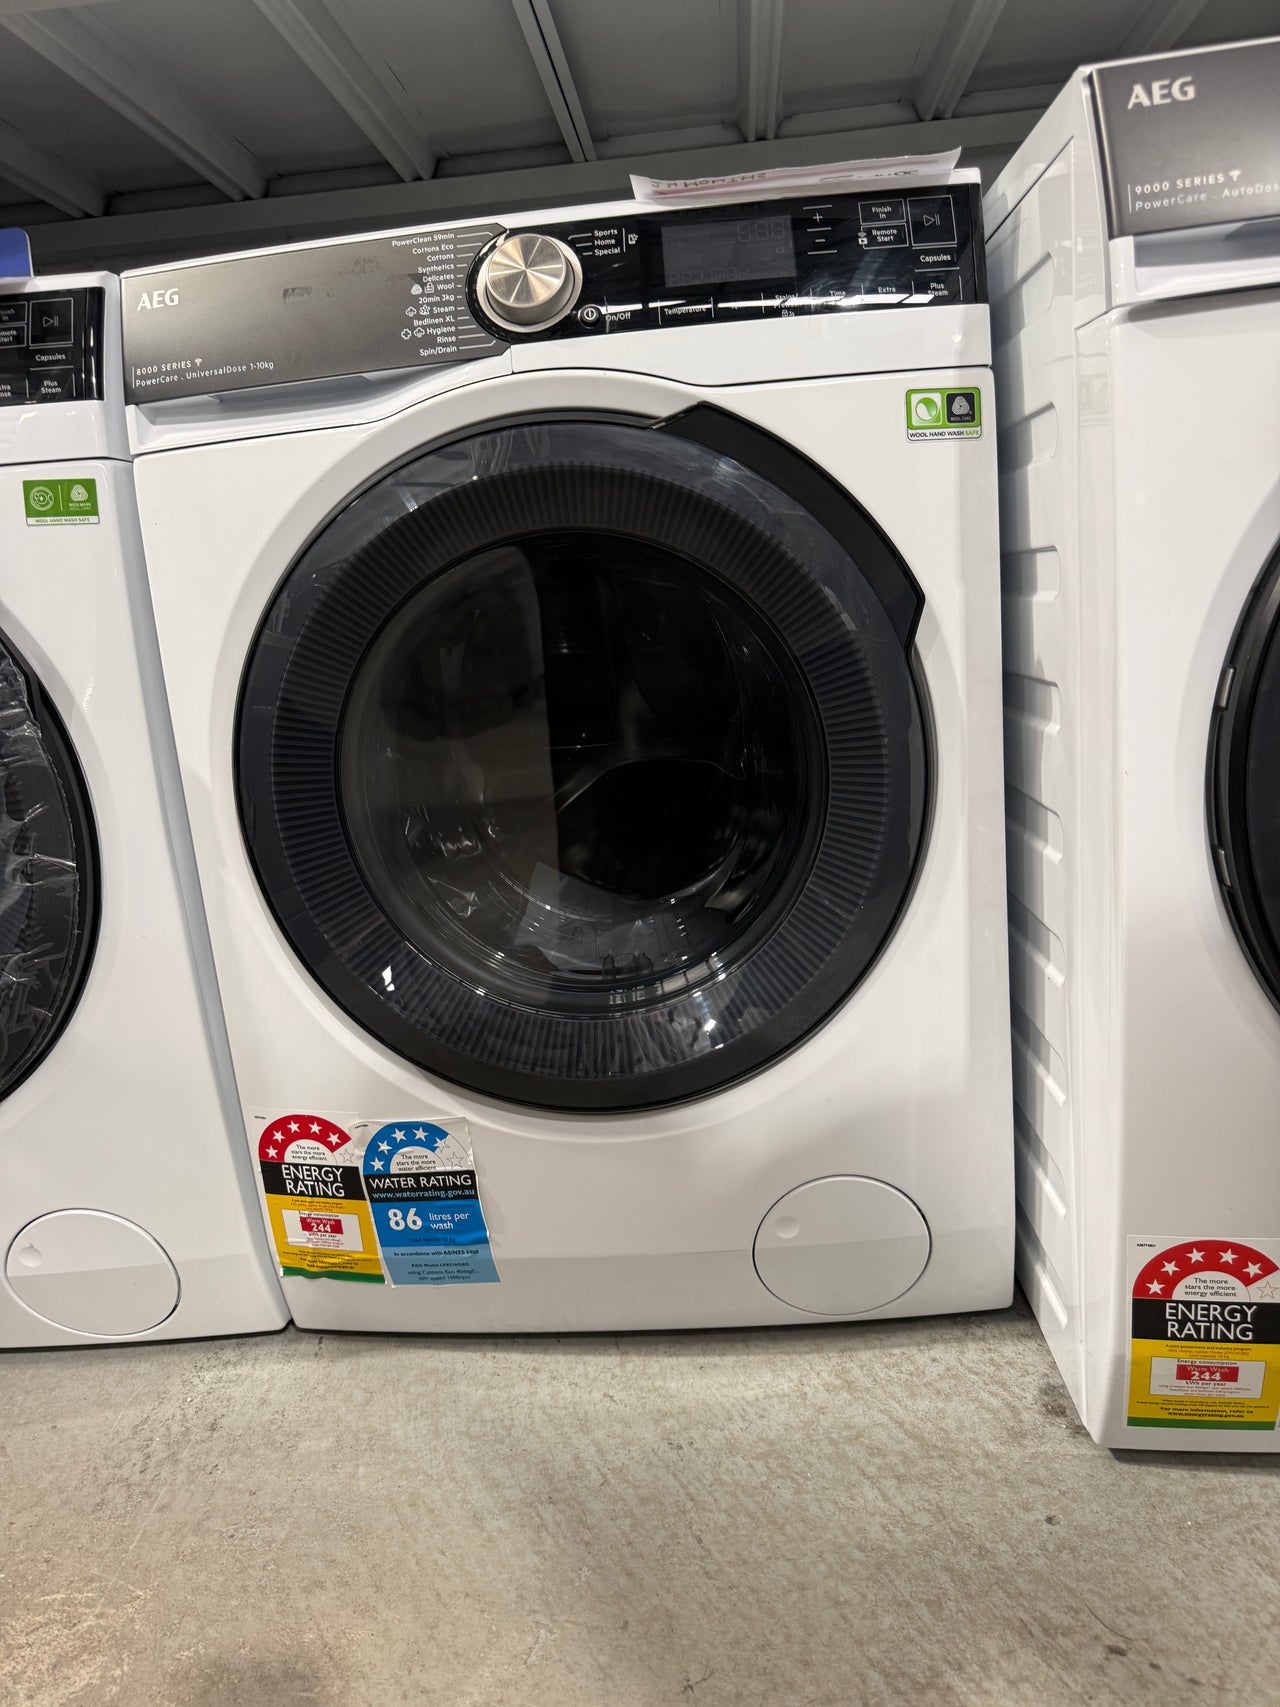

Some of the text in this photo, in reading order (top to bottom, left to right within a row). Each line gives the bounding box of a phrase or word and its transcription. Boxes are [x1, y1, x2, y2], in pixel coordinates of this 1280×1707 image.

[1128, 76, 1195, 109] AEG
[1135, 173, 1225, 195] 9000 SERIES
[1135, 182, 1280, 211] PowerCare AutoDos
[872, 206, 892, 214] Finish
[594, 229, 618, 237] Sports
[392, 233, 455, 247] PowerClean 59min
[412, 246, 439, 255] Cottons
[594, 247, 620, 257] Special
[427, 253, 454, 262] Cottons
[920, 254, 951, 263] Capsules
[418, 263, 454, 274] Synthetics
[422, 273, 454, 282] Delicates
[437, 283, 455, 291] Wool
[137, 288, 179, 311] AEG
[418, 296, 440, 304] 20min
[432, 306, 455, 314] Steam
[413, 317, 444, 327] Bedlinen
[605, 312, 631, 322] On/Off
[427, 326, 456, 335] Hygiene
[437, 335, 457, 344] Rinse
[419, 346, 457, 357] Spin/Drain
[35, 353, 66, 362] Capsules
[136, 360, 192, 376] 8000 SERIES
[136, 361, 274, 388] PowerCare UniversalDose 1-10kg
[41, 386, 62, 394] Steam
[281, 1164, 343, 1182] ENERGY
[369, 1174, 472, 1189] WATER RATING
[286, 1180, 345, 1197] RATING
[372, 1189, 475, 1199] www.waterrating.gov.au
[388, 1208, 422, 1231] 86
[428, 1212, 470, 1222] litres per
[311, 1223, 331, 1233] 244
[430, 1221, 454, 1230] wash
[1165, 1302, 1258, 1324] ENERGY
[1167, 1321, 1253, 1341] RATING
[1191, 1371, 1221, 1381] 244
